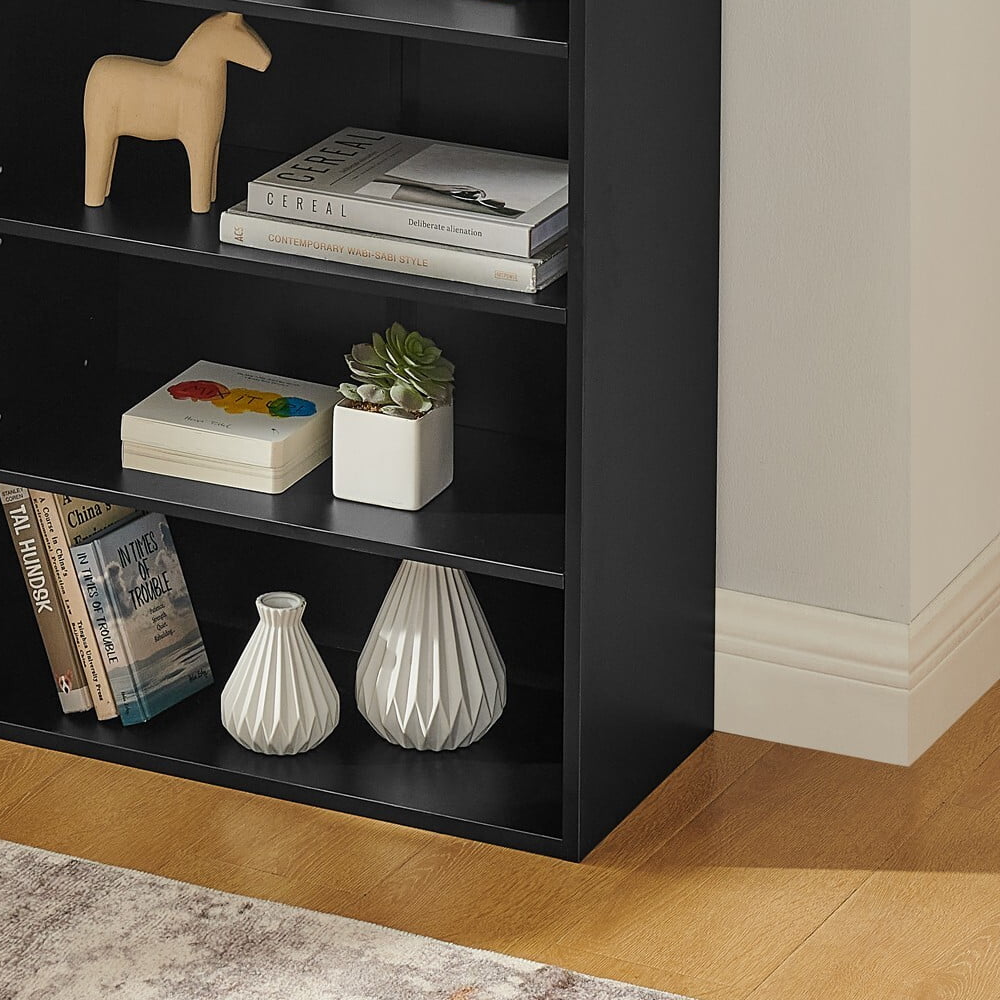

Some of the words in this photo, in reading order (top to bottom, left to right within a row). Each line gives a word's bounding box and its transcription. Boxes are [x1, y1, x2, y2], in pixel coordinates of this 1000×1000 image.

[276, 134, 386, 183] CEREAL
[267, 192, 346, 218] CEREAL
[408, 218, 445, 231] Deliberate
[446, 224, 483, 237] alienation
[268, 233, 344, 253] CONTEMPORARY
[347, 247, 397, 263] WABI-SABI
[398, 255, 429, 268] STYLE
[5, 493, 24, 502] COREN
[9, 504, 31, 536] TAL
[42, 506, 54, 533] Course
[55, 548, 68, 577] China's
[77, 552, 89, 565] IN
[117, 545, 131, 568] IN
[129, 531, 158, 562] TIMES
[18, 538, 53, 614] HUNDSK
[81, 568, 99, 598] TIMES
[138, 557, 150, 580] OF
[92, 601, 104, 614] OF
[128, 570, 173, 610] TROUBLE
[96, 616, 119, 665] TROUBLE
[85, 650, 99, 683] University
